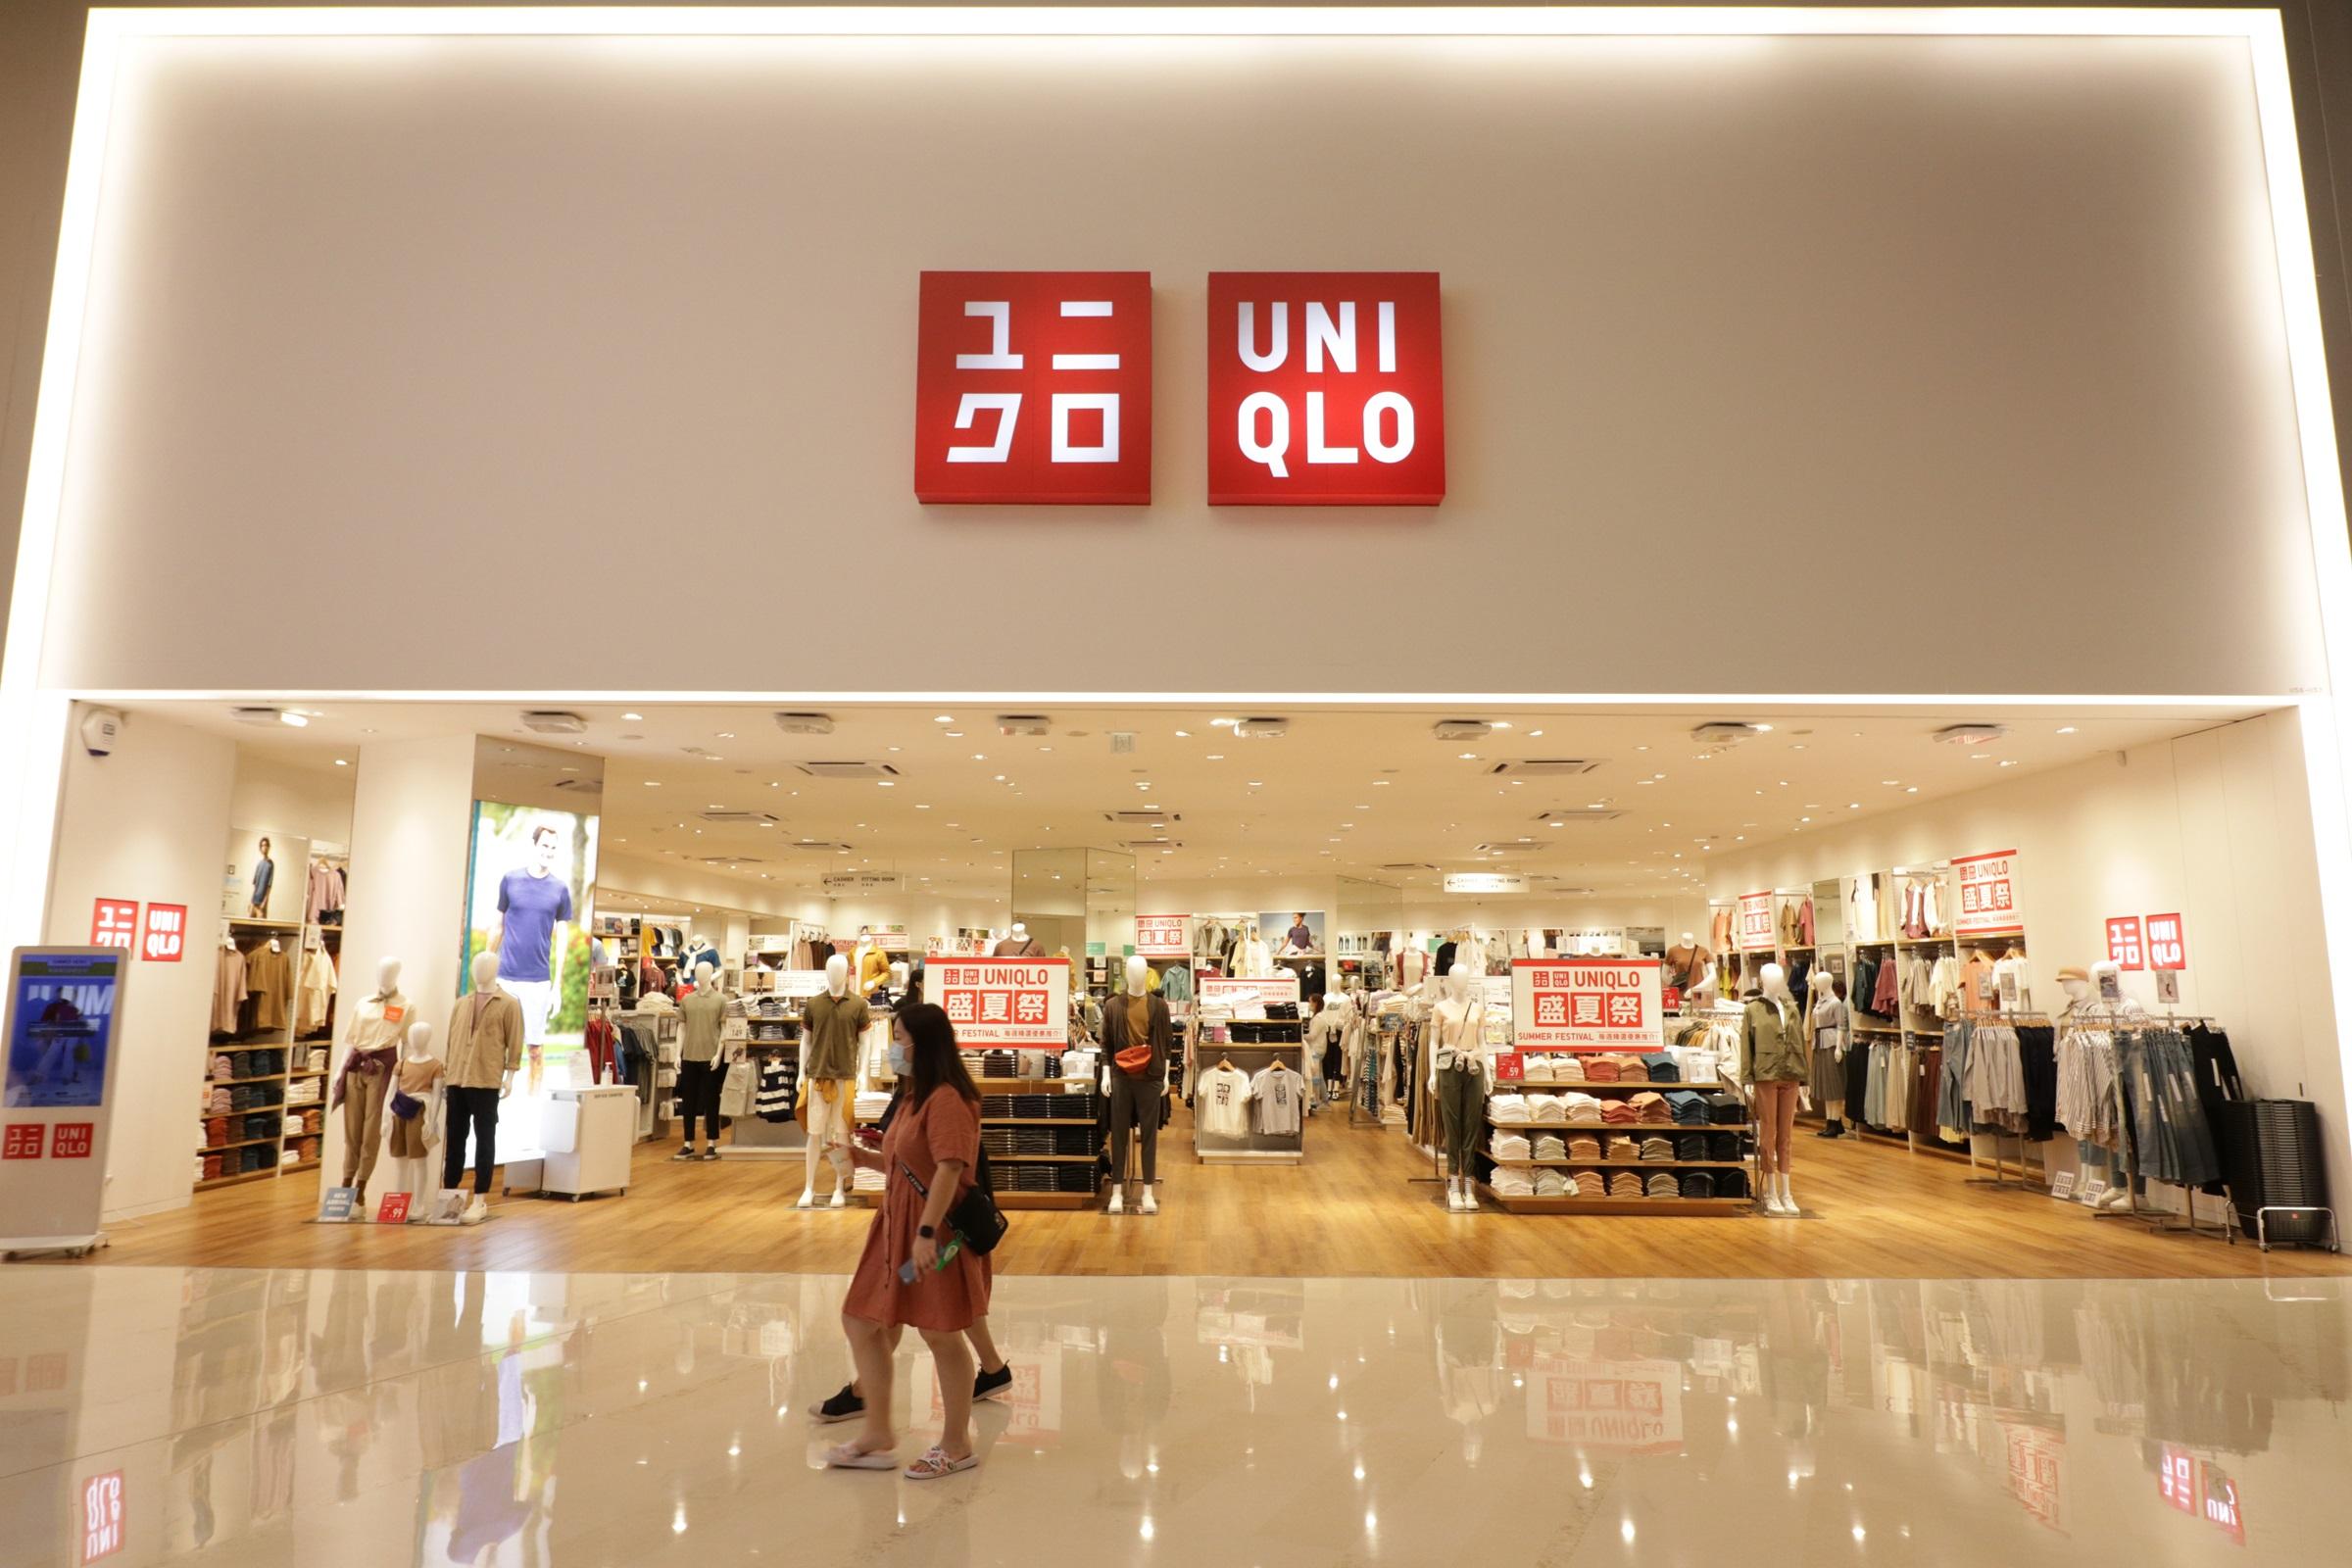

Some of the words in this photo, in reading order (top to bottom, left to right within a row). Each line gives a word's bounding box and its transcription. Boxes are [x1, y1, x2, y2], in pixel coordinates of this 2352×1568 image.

[956, 301, 1120, 369] ユニ
[1238, 301, 1396, 372] UNI
[1238, 391, 1415, 477] QLO
[1978, 860, 2008, 878] UNIQLO
[149, 909, 180, 932] UNI
[1154, 919, 1182, 928] UNIQLO
[2149, 920, 2177, 941] UNI
[146, 933, 180, 957] QLO
[2151, 942, 2181, 965] QLO
[984, 968, 1049, 988] UNIQLO
[1574, 970, 1641, 990] UNIQLO
[947, 993, 1046, 1021] 盛夏祭
[1538, 996, 1639, 1024] 盛夏祭
[1518, 1032, 1552, 1041] SUMMER
[1554, 1032, 1594, 1041] FESTIVAL
[59, 1127, 86, 1140] UNI
[56, 1142, 87, 1156] QLO
